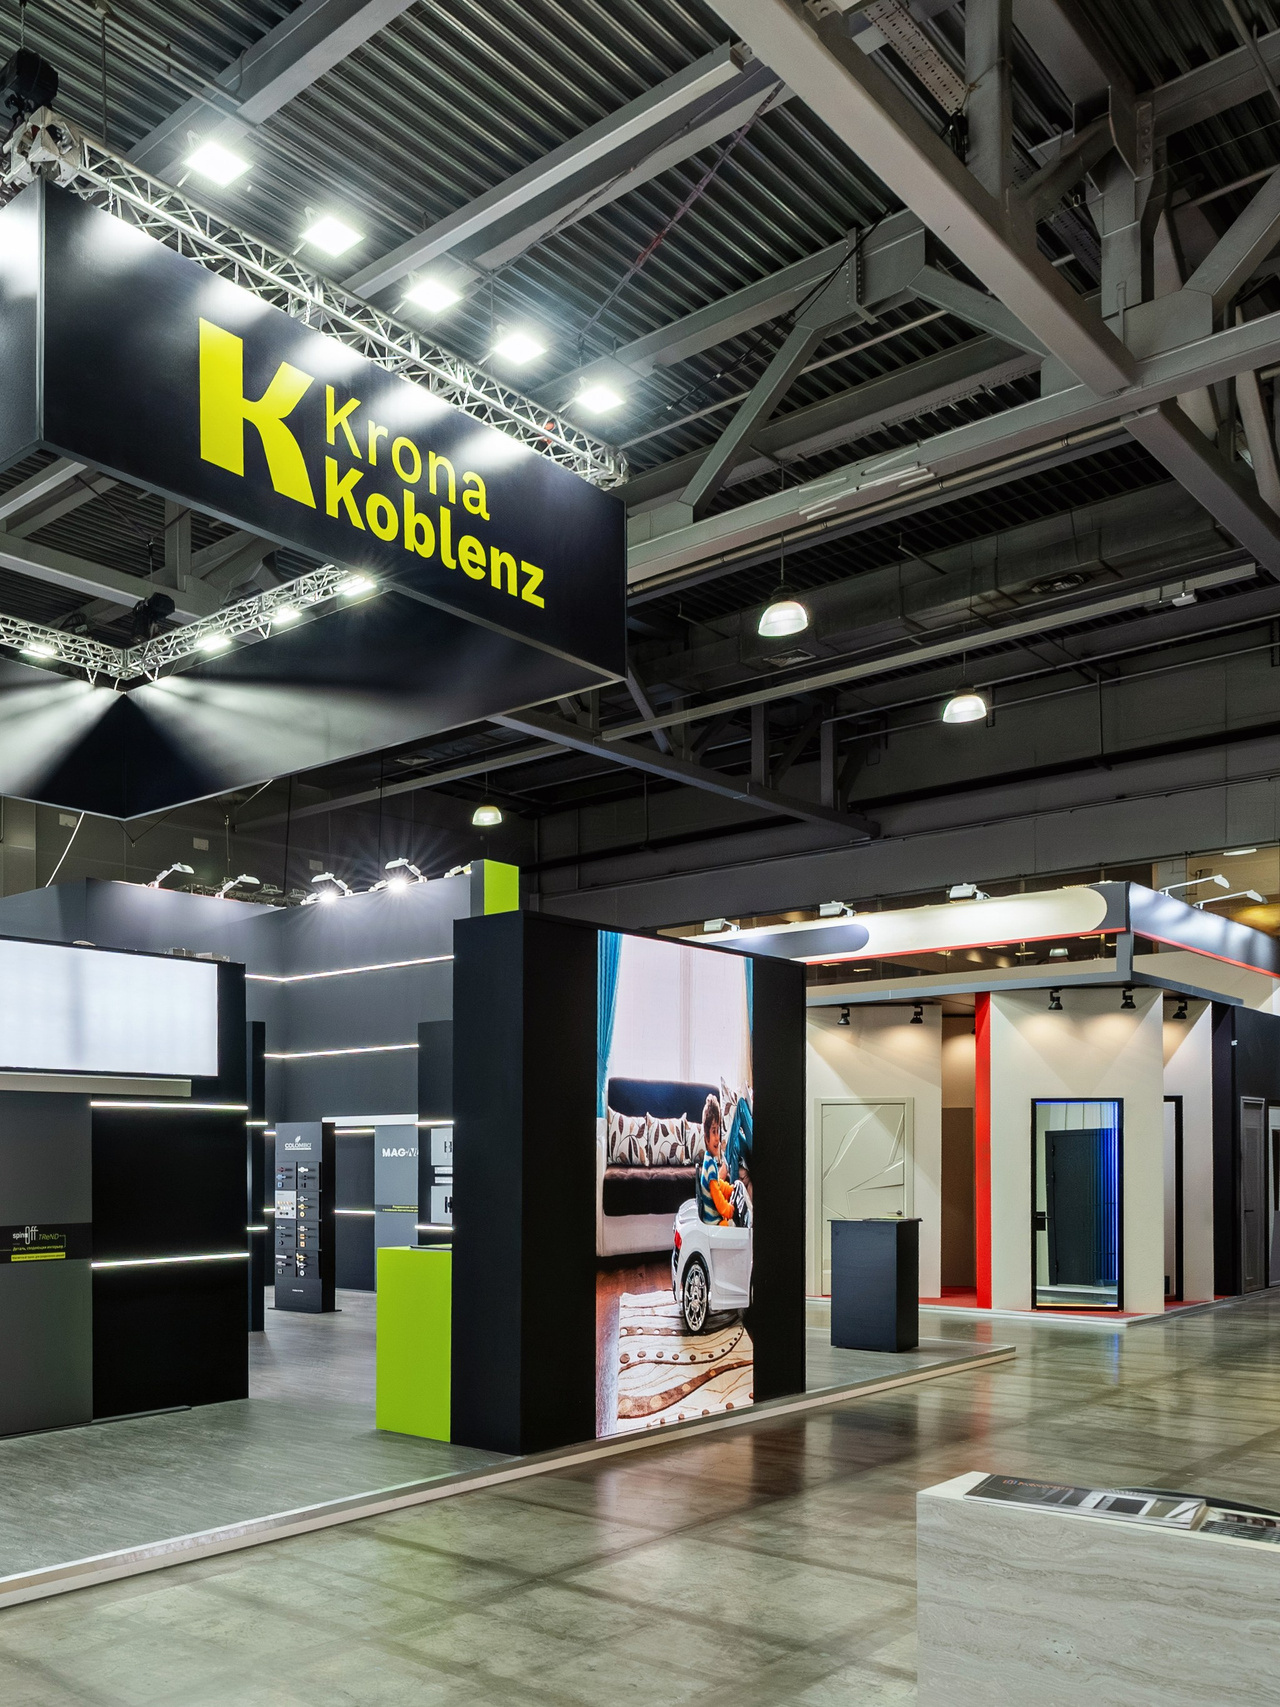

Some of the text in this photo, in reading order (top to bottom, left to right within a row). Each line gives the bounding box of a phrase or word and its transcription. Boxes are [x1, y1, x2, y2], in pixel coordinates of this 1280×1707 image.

[199, 317, 317, 509] K
[325, 384, 490, 521] Krona
[325, 455, 545, 609] Koblenz
